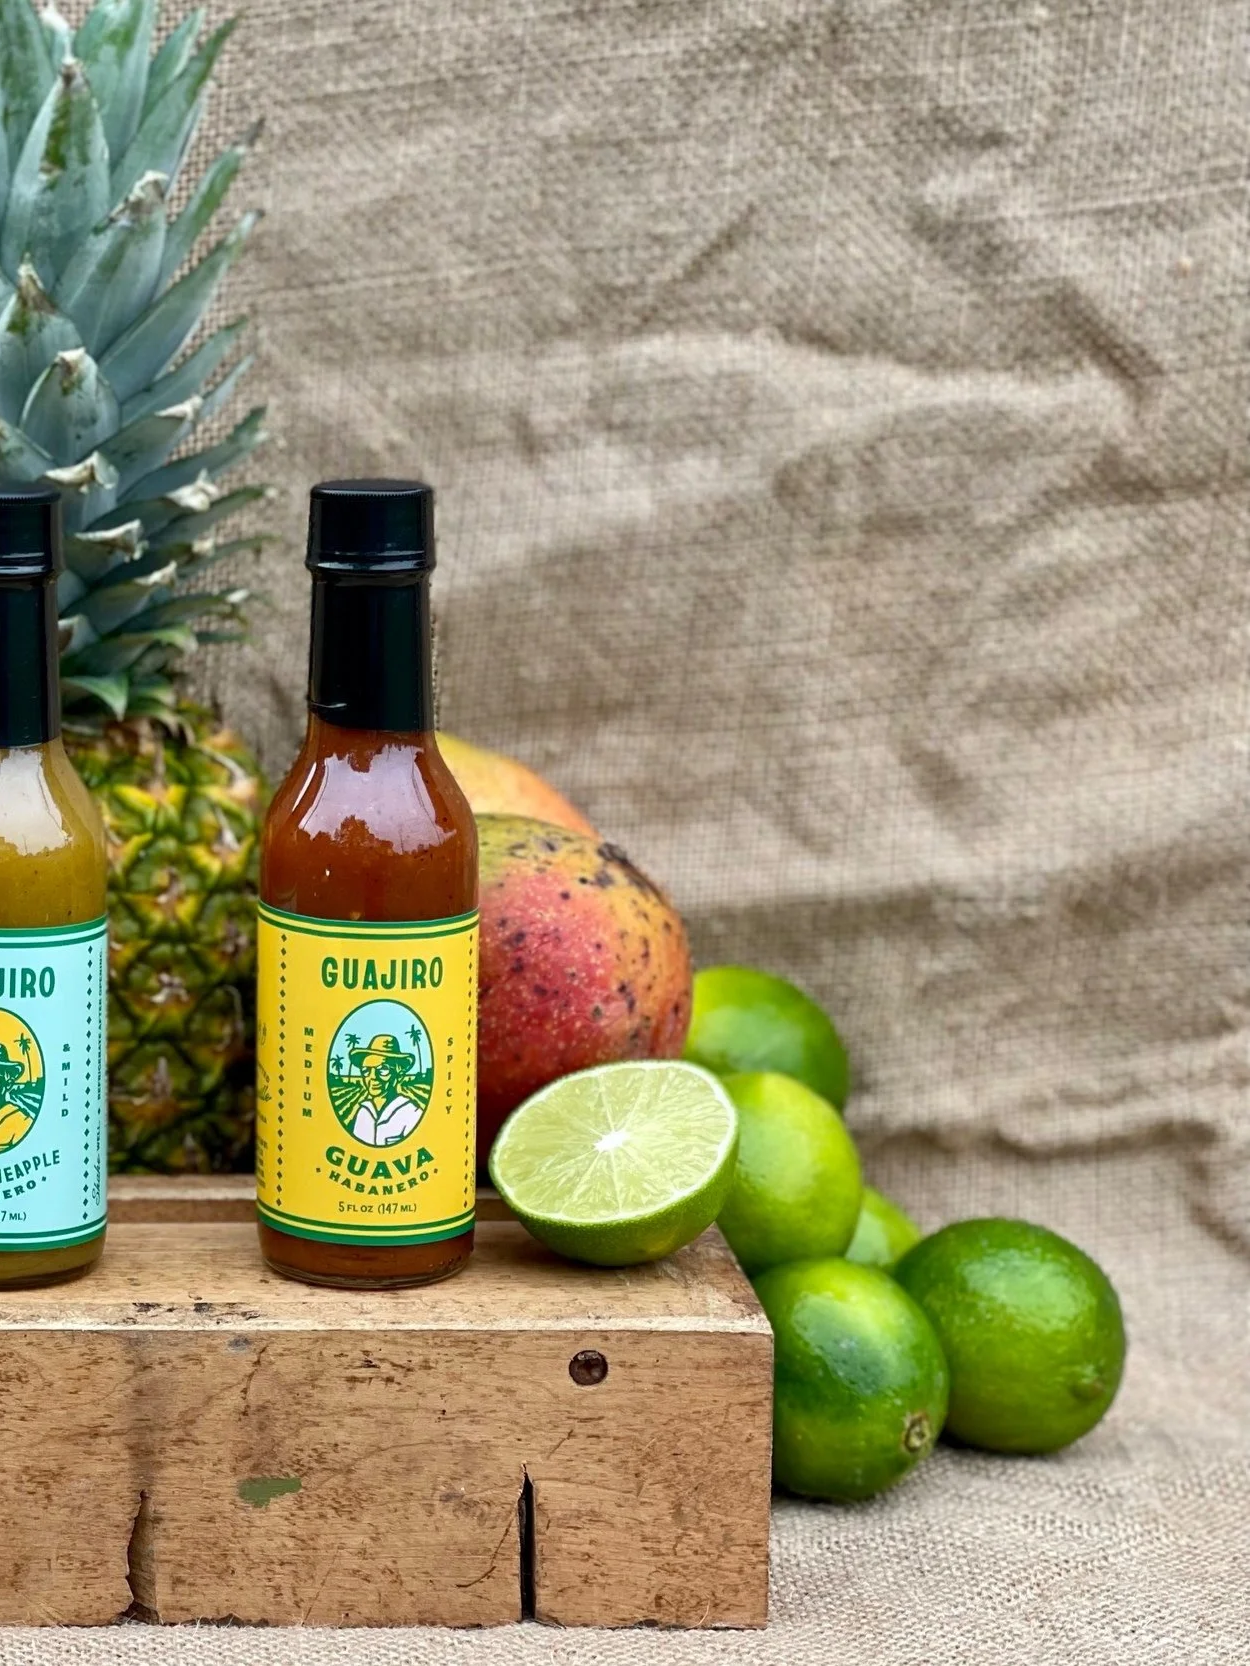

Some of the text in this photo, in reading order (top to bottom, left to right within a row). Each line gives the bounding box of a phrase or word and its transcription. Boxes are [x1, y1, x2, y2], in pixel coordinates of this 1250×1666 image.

[321, 957, 443, 990] GUAJIRO
[62, 1044, 71, 1118] & MILD
[302, 1027, 314, 1118] MEDIUM
[326, 1146, 434, 1179] GUAVA
[329, 1170, 429, 1196] HABANERO
[10, 1212, 27, 1221] ML)
[339, 1201, 417, 1214] 5 FL OZ (147 ML)
